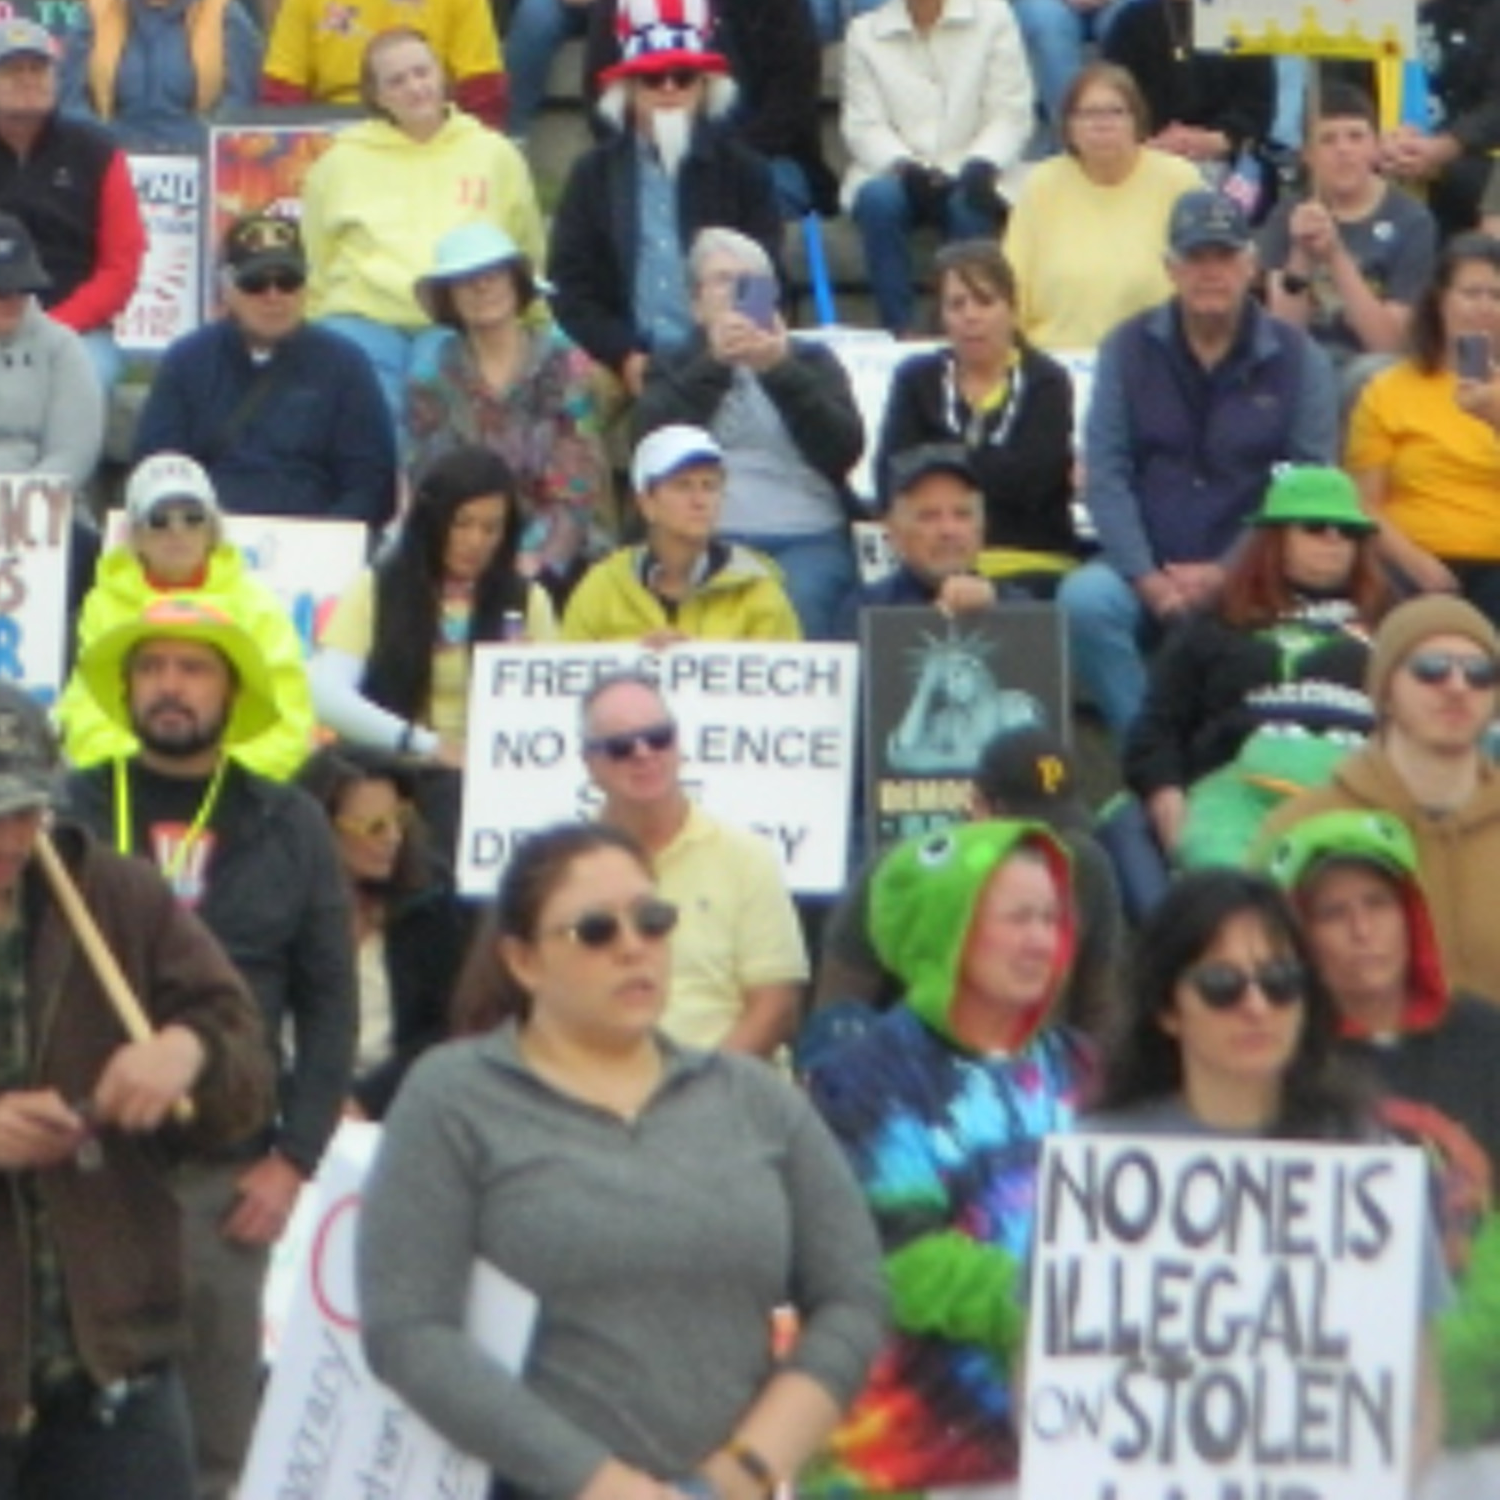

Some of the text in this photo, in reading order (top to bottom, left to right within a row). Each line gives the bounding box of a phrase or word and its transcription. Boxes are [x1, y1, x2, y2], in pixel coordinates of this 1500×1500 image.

[491, 725, 566, 769] NO
[1044, 1145, 1393, 1261] NO ONE IS
[1044, 1255, 1350, 1359] ILLEGAL
[1111, 1359, 1394, 1466] STOLEN
